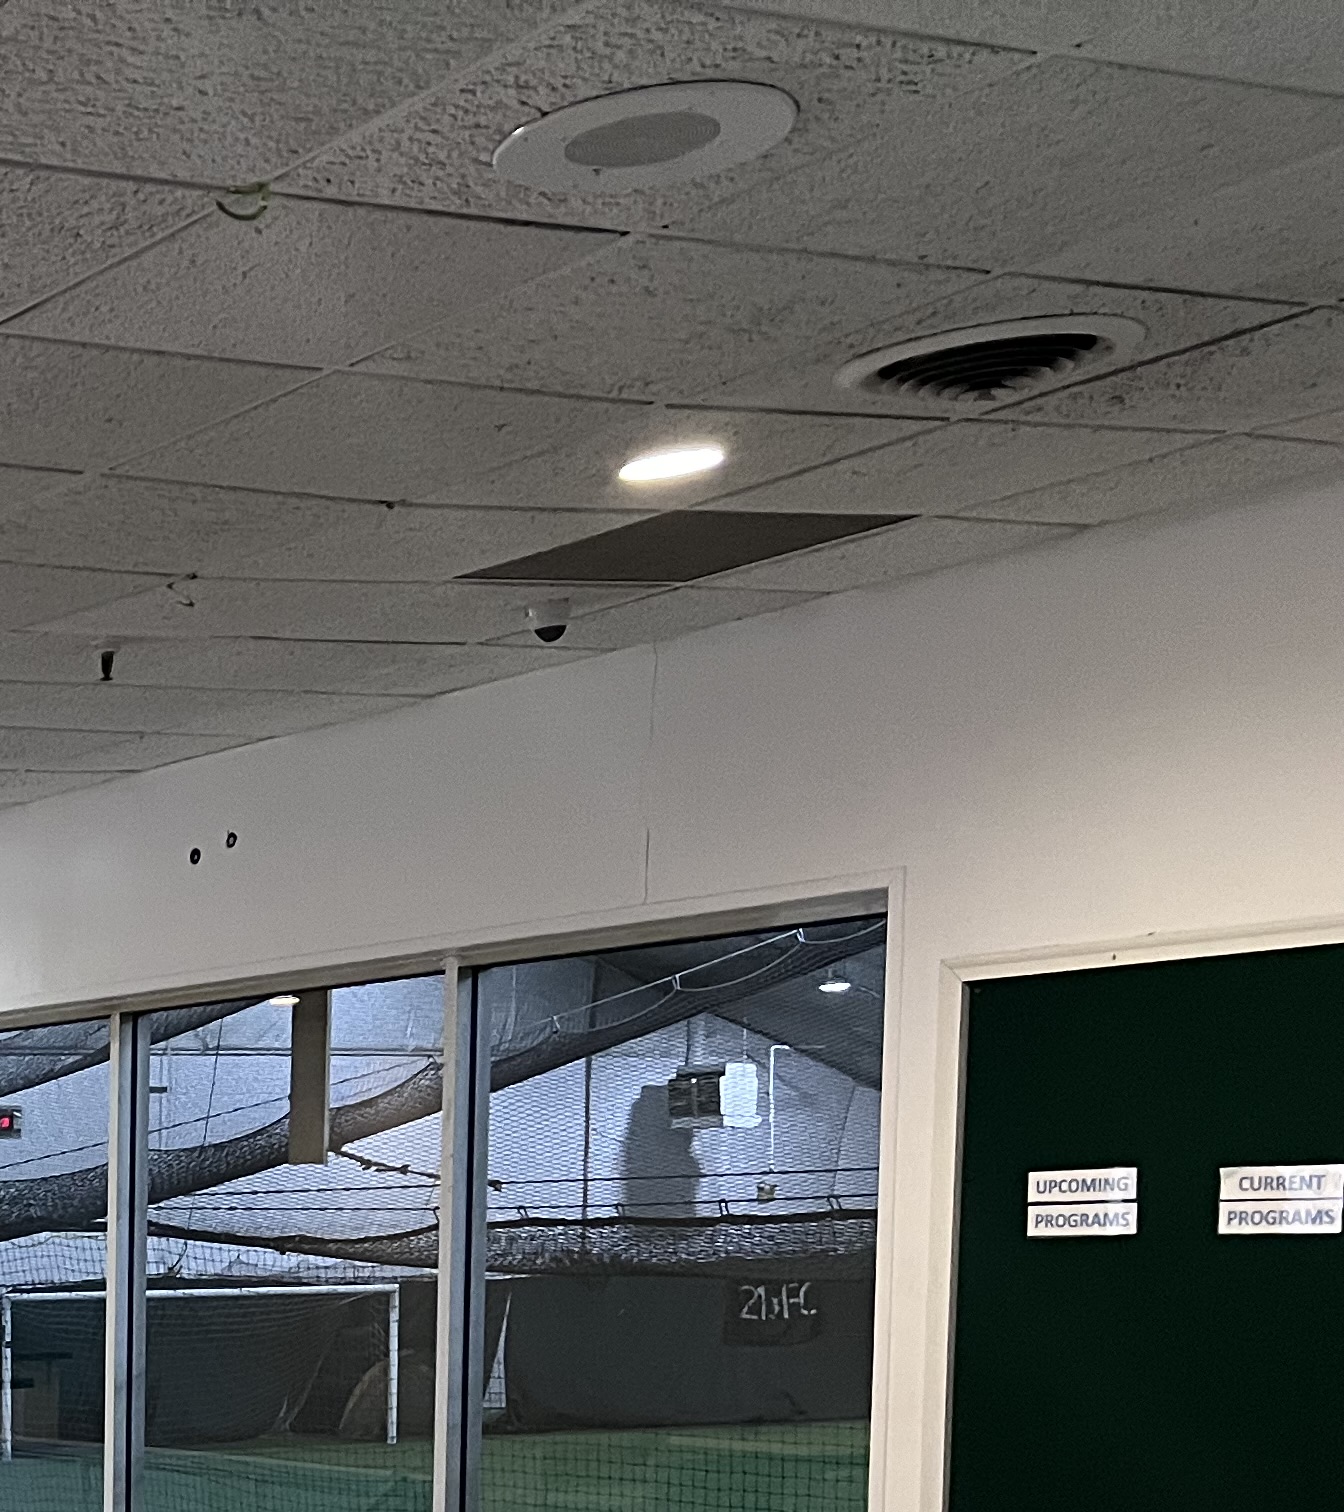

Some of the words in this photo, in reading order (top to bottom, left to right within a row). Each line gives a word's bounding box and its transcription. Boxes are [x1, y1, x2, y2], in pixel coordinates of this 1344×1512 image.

[1036, 1175, 1130, 1195] UPCOMING
[1238, 1173, 1327, 1193] CURRENT
[1034, 1211, 1131, 1230] PROGRAMS
[1226, 1207, 1336, 1227] PROGRAMS
